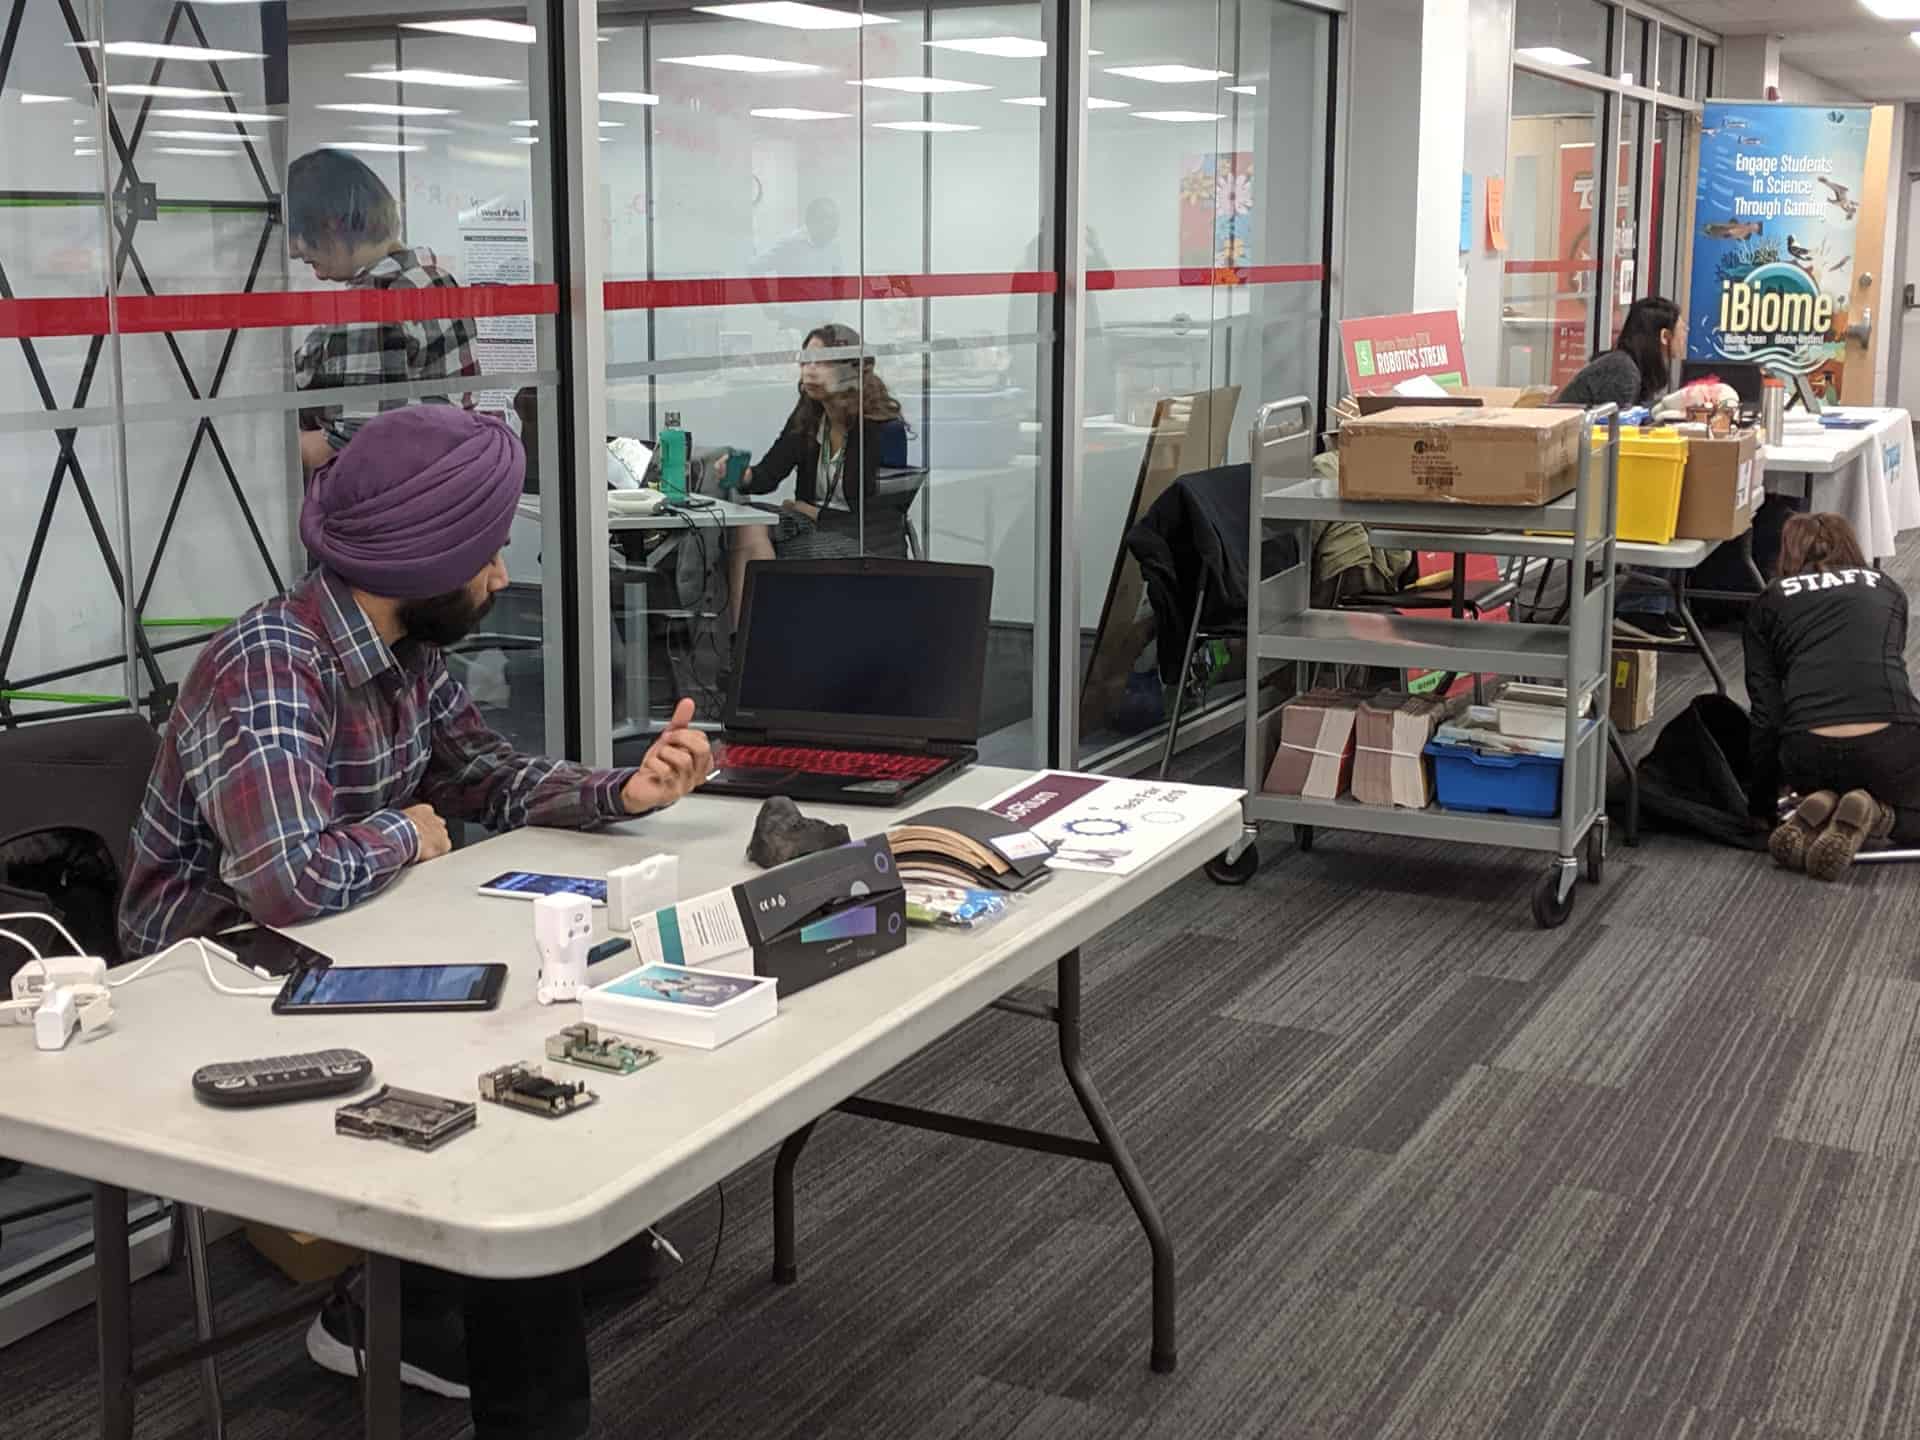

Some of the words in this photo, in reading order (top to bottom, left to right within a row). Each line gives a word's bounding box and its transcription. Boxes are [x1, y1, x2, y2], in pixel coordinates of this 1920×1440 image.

[1735, 152, 1778, 176] Engage
[1780, 154, 1833, 173] Students
[1752, 176, 1764, 194] in
[1766, 176, 1812, 195] Science
[480, 208, 501, 217] West
[502, 208, 521, 217] Park
[1734, 196, 1782, 220] Through
[1783, 198, 1826, 221] Gaming
[1720, 279, 1833, 333] iBiome
[1376, 348, 1419, 375] ROBOTICS
[1419, 344, 1449, 368] STREAM
[1781, 568, 1881, 597] STAFF
